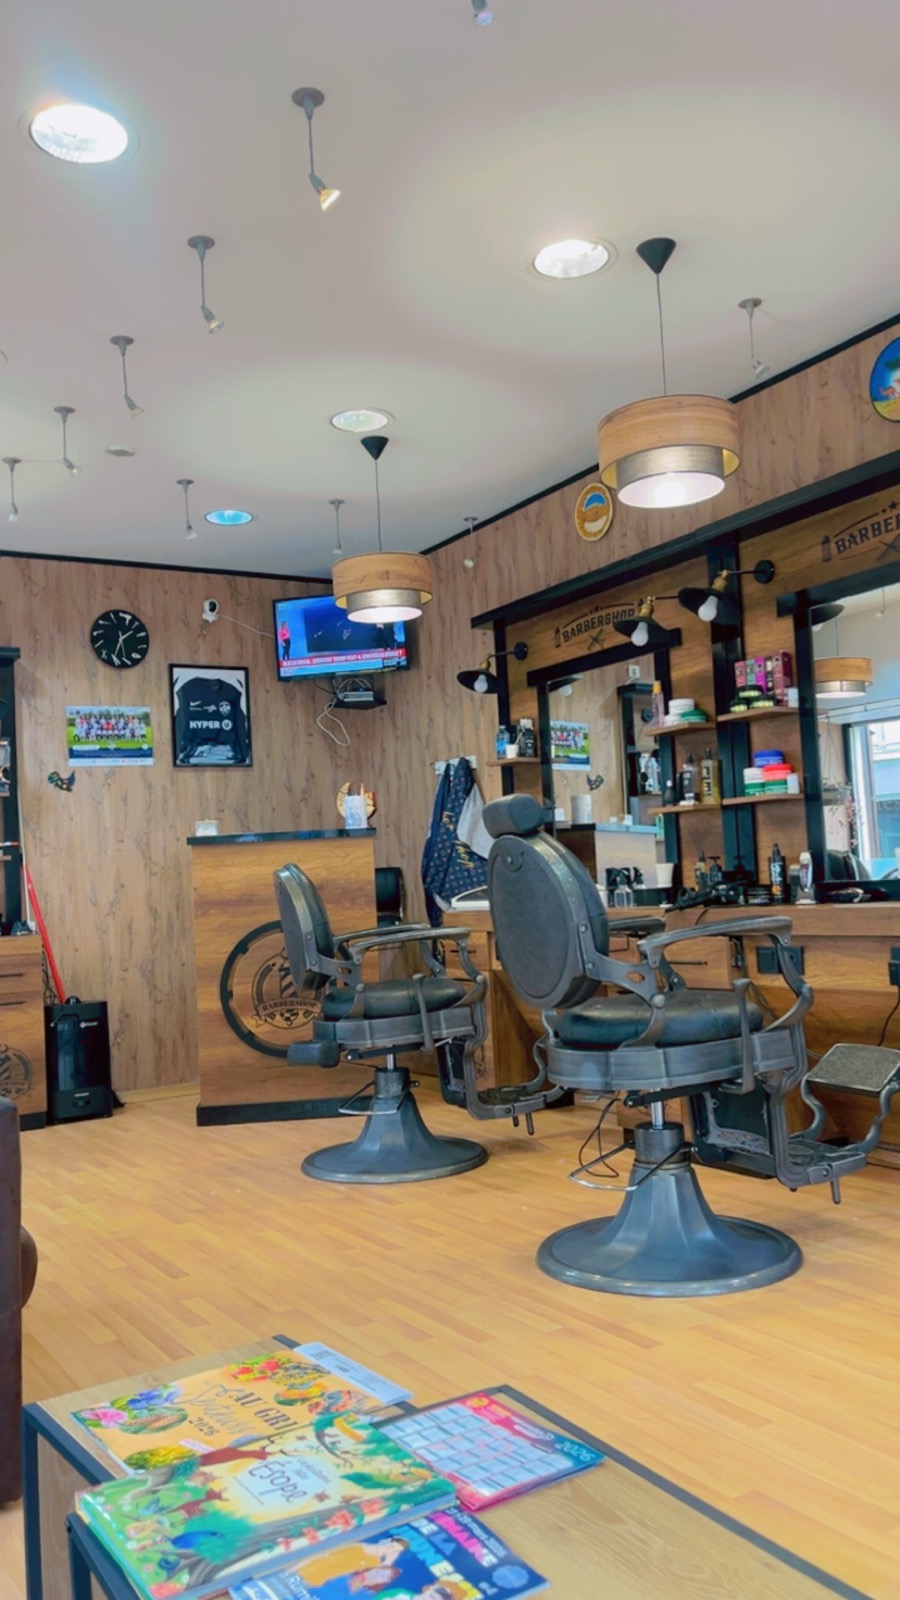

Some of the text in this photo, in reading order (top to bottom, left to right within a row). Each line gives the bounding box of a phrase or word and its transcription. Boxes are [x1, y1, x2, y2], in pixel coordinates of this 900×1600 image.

[562, 608, 635, 642] BARBERSHOP
[190, 720, 220, 729] HYPER
[262, 1001, 317, 1012] BARBERSHOP
[189, 1417, 220, 1436] 2026
[554, 1441, 596, 1461] 2026
[429, 1532, 457, 1556] LA
